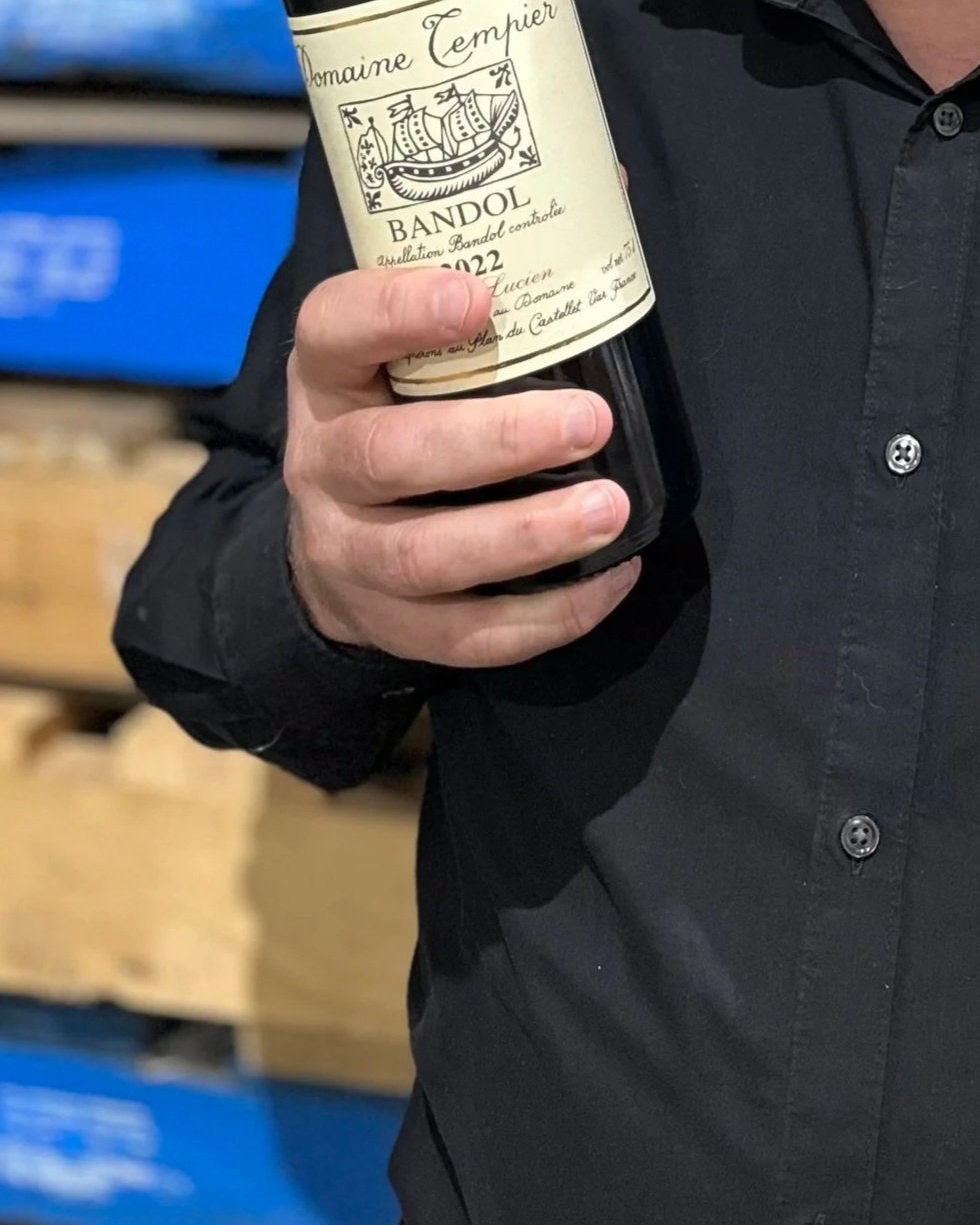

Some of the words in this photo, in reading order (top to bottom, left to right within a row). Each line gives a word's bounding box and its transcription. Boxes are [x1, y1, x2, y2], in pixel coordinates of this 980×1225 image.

[297, 44, 414, 88] Domaine
[422, 1, 558, 68] Tempier
[387, 185, 531, 243] BANDOL
[448, 219, 506, 254] Bandol
[440, 249, 504, 277] 022
[482, 268, 554, 299] Lucien
[514, 280, 576, 311] Domaine
[447, 343, 465, 355] au
[468, 329, 504, 354] Plan
[505, 321, 526, 339] du
[528, 297, 583, 336] Castellet
